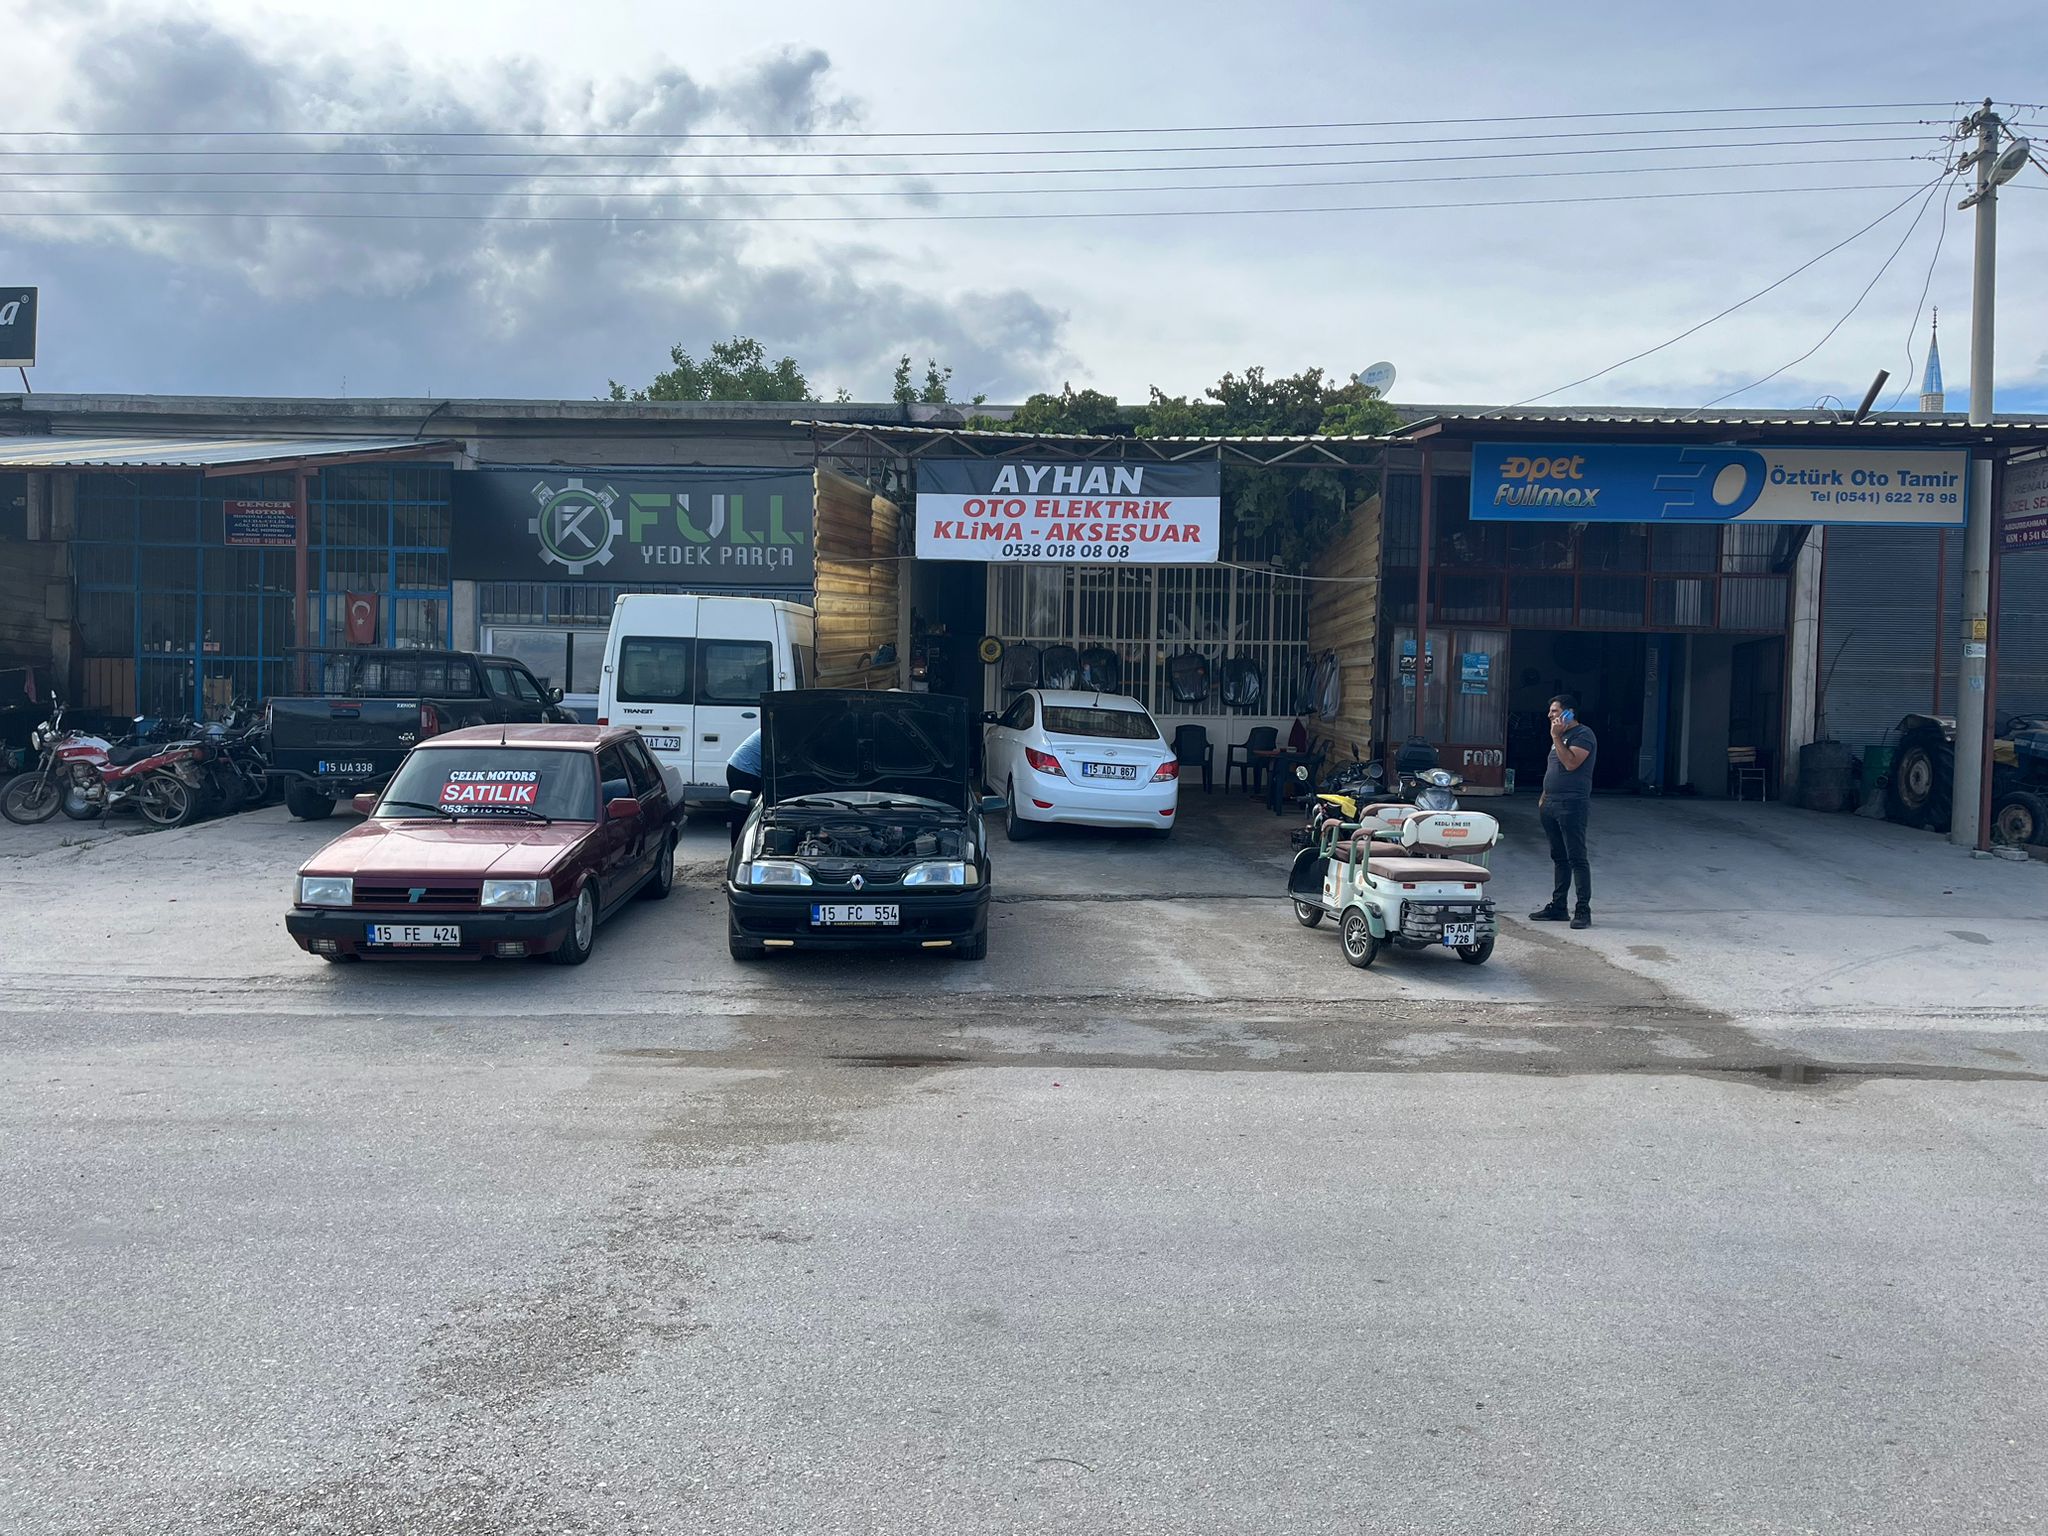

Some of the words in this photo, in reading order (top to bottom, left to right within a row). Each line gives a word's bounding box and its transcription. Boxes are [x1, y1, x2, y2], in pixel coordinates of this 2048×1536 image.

[991, 465, 1144, 495] AYHAN
[1770, 465, 1843, 486] Öztürk
[1851, 469, 1889, 487] Oto
[1897, 470, 1958, 488] Tamir
[1811, 491, 1831, 502] Tel
[1835, 491, 1880, 505] (0541)
[1885, 493, 1912, 504] 622
[1918, 493, 1935, 504] 78
[1940, 493, 1958, 504] 98
[963, 499, 1027, 518] OTO
[629, 493, 805, 545] FULL
[1047, 522, 1201, 543] AKSESUAR
[641, 546, 712, 566] YEDEK
[720, 547, 794, 571] PARÇA
[1002, 543, 1042, 558] 0538
[1046, 544, 1075, 558] 018
[1080, 544, 1103, 558] 08
[1107, 545, 1130, 559] 08
[663, 738, 679, 748] 473
[1463, 749, 1504, 766] FORD
[326, 762, 337, 772] 15
[340, 762, 354, 772] UA
[355, 762, 373, 772] 338
[1089, 763, 1098, 774] 15
[1101, 765, 1117, 775] ADJ
[1120, 766, 1135, 777] 867
[486, 771, 537, 781] MOTORS
[443, 784, 534, 802] SATILIK
[822, 906, 836, 921] 15
[847, 906, 863, 921] FC
[874, 906, 898, 921] 554
[377, 927, 392, 941] 15
[404, 927, 421, 941] FE
[433, 927, 458, 941] 424
[1446, 924, 1456, 933] 15
[1453, 934, 1470, 944] 726
